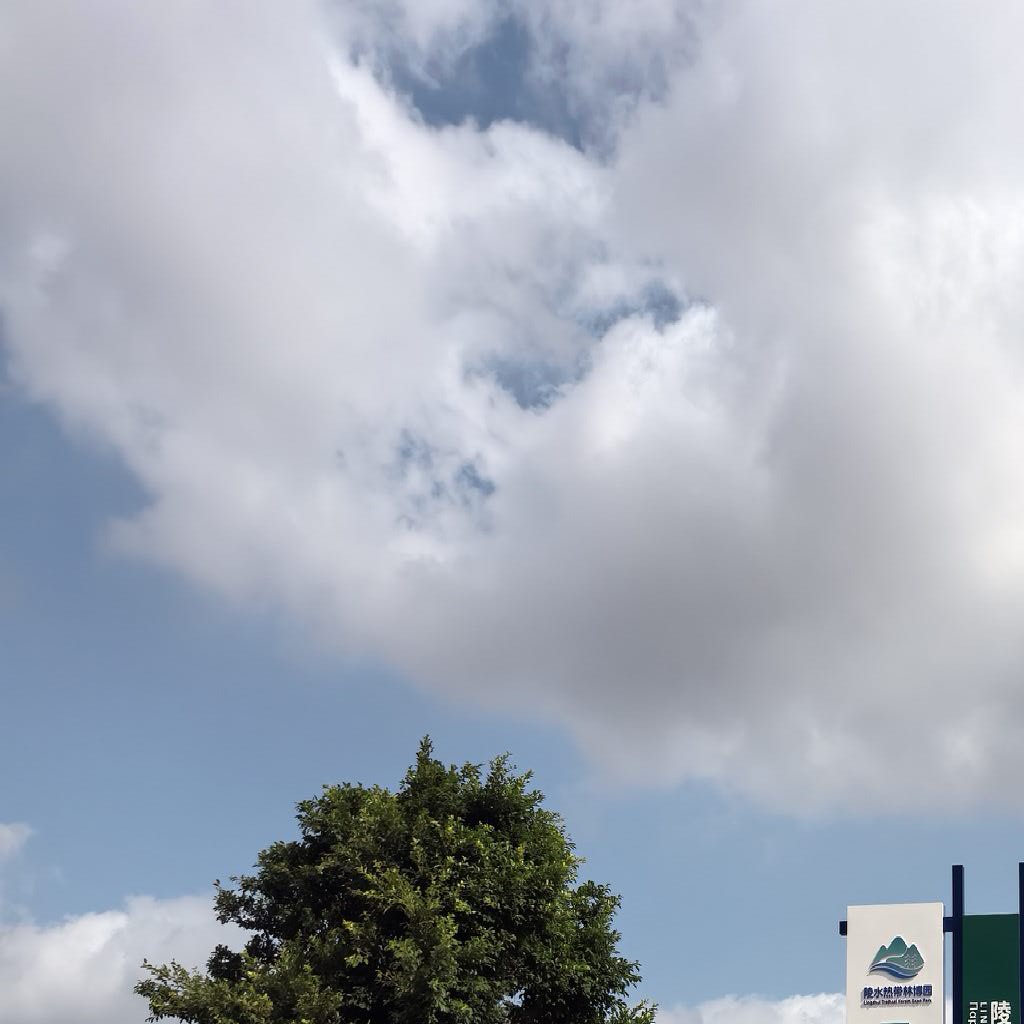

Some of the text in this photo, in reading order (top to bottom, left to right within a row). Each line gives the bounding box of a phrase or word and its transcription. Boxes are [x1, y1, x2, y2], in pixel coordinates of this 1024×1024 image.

[863, 985, 933, 1000] 陵水热带林博园
